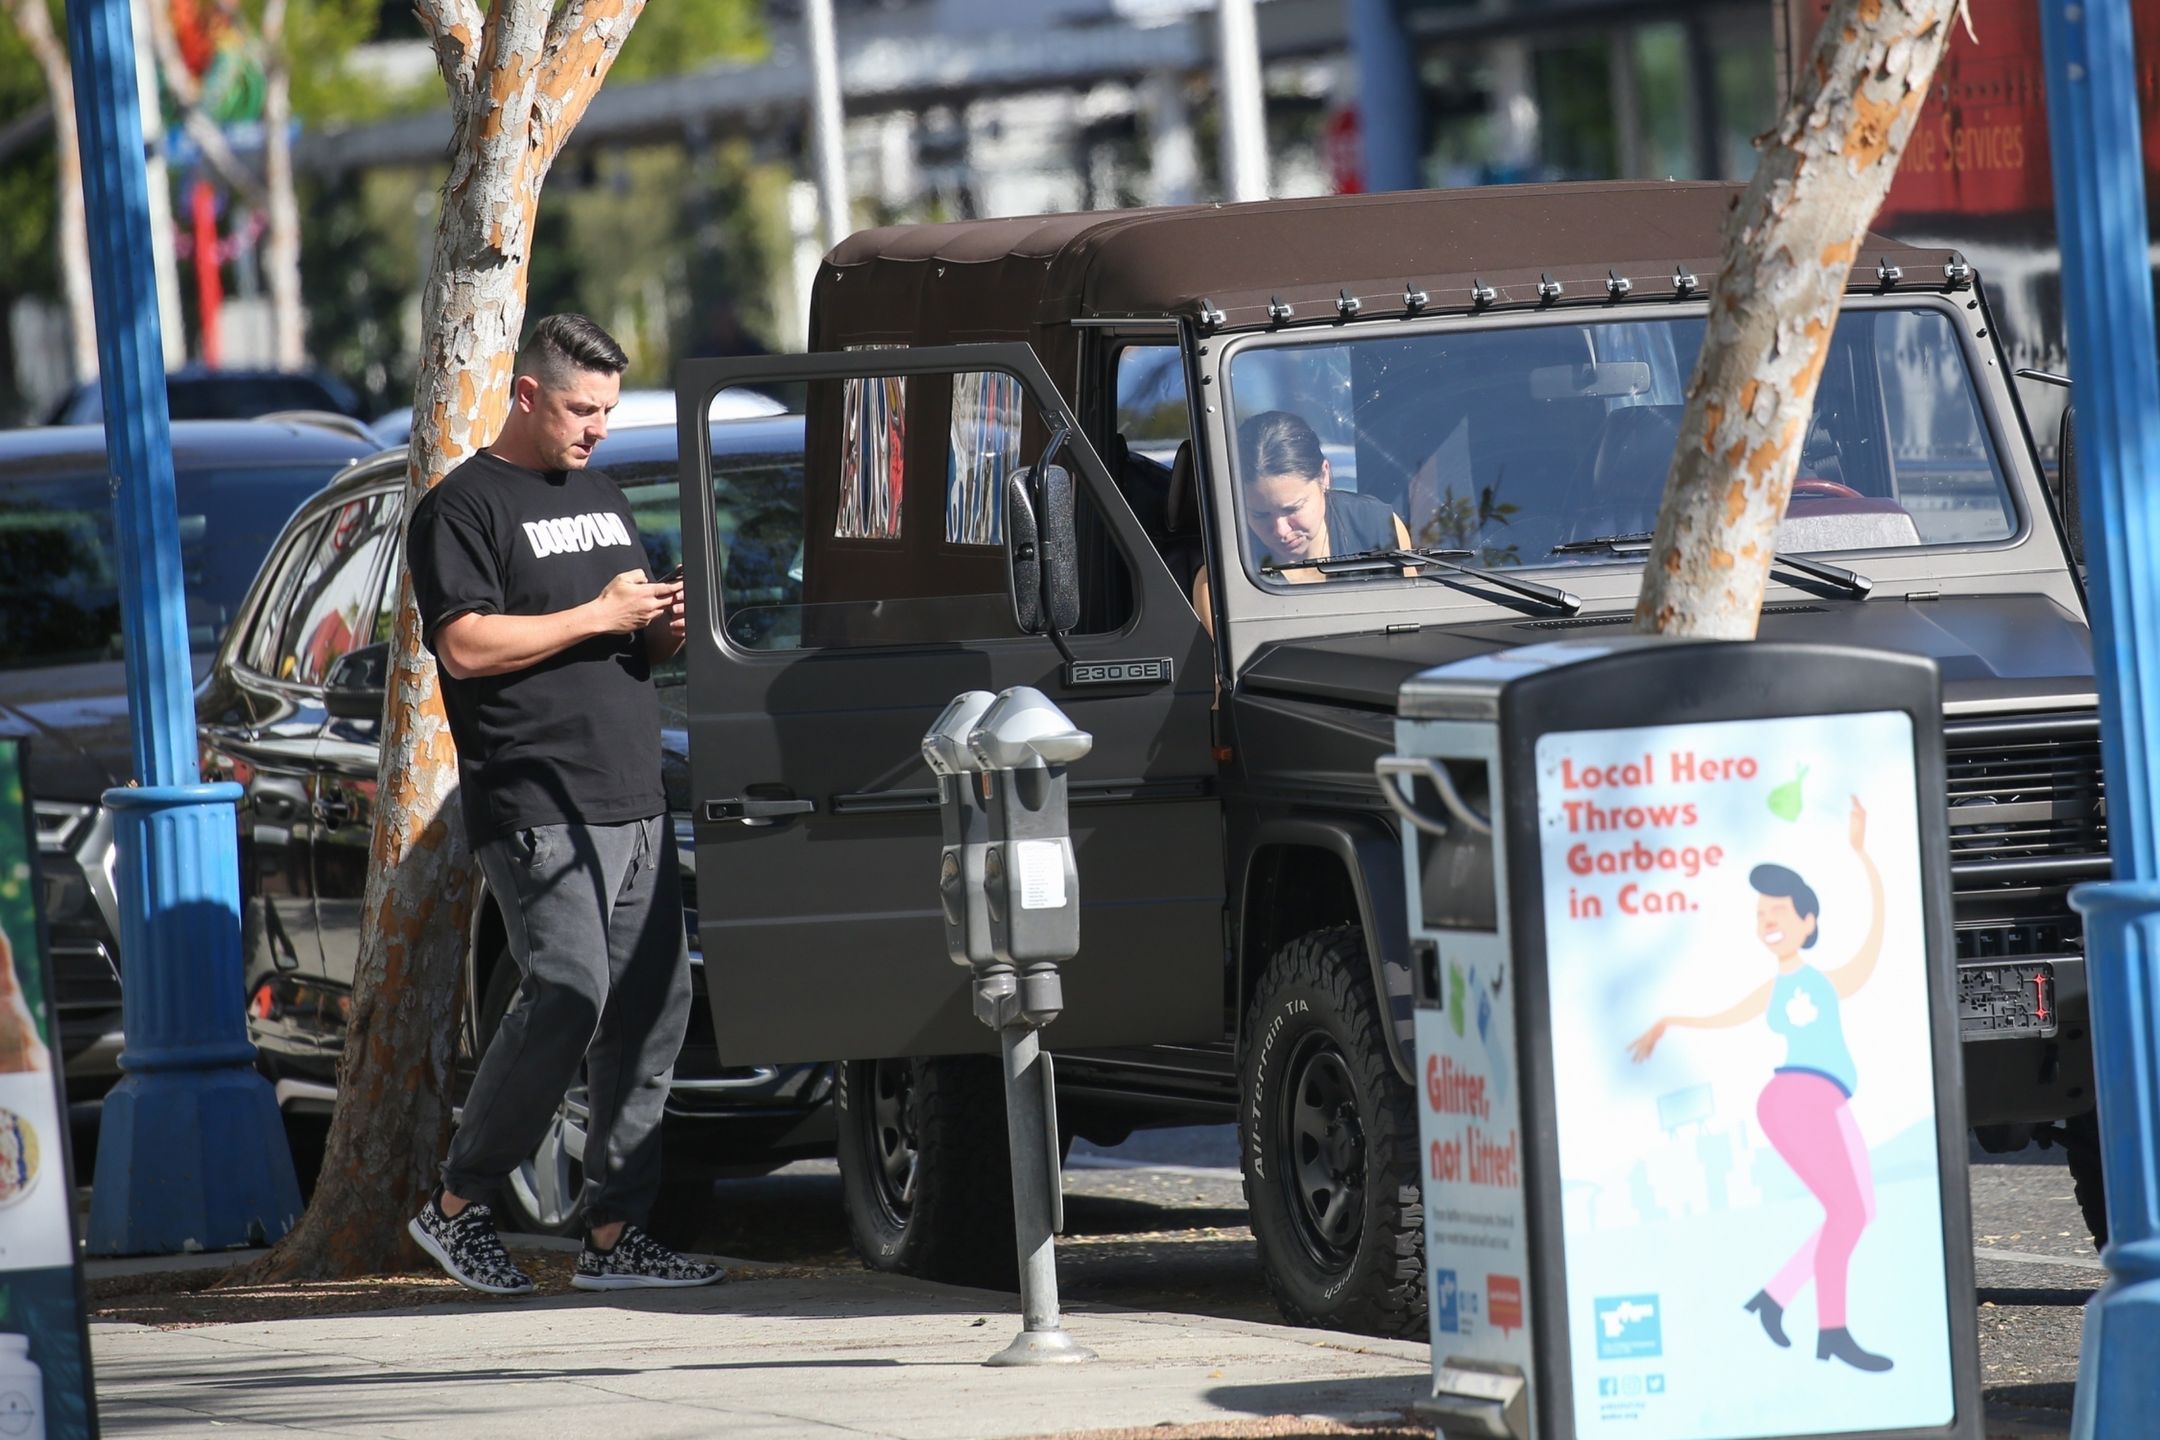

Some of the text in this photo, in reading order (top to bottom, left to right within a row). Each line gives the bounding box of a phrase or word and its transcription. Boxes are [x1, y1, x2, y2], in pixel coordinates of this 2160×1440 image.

[1942, 112, 2024, 171] Services
[1076, 664, 1158, 680] 230 GE
[1561, 752, 1759, 790] Local Hero
[1562, 800, 1698, 833] Throws
[1567, 840, 1724, 878] Garbage
[1569, 883, 1699, 919] in Can.
[1252, 999, 1309, 1180] All-Terrain T/A
[1427, 1053, 1490, 1122] Glitter,
[1430, 1124, 1519, 1190] not Litter!
